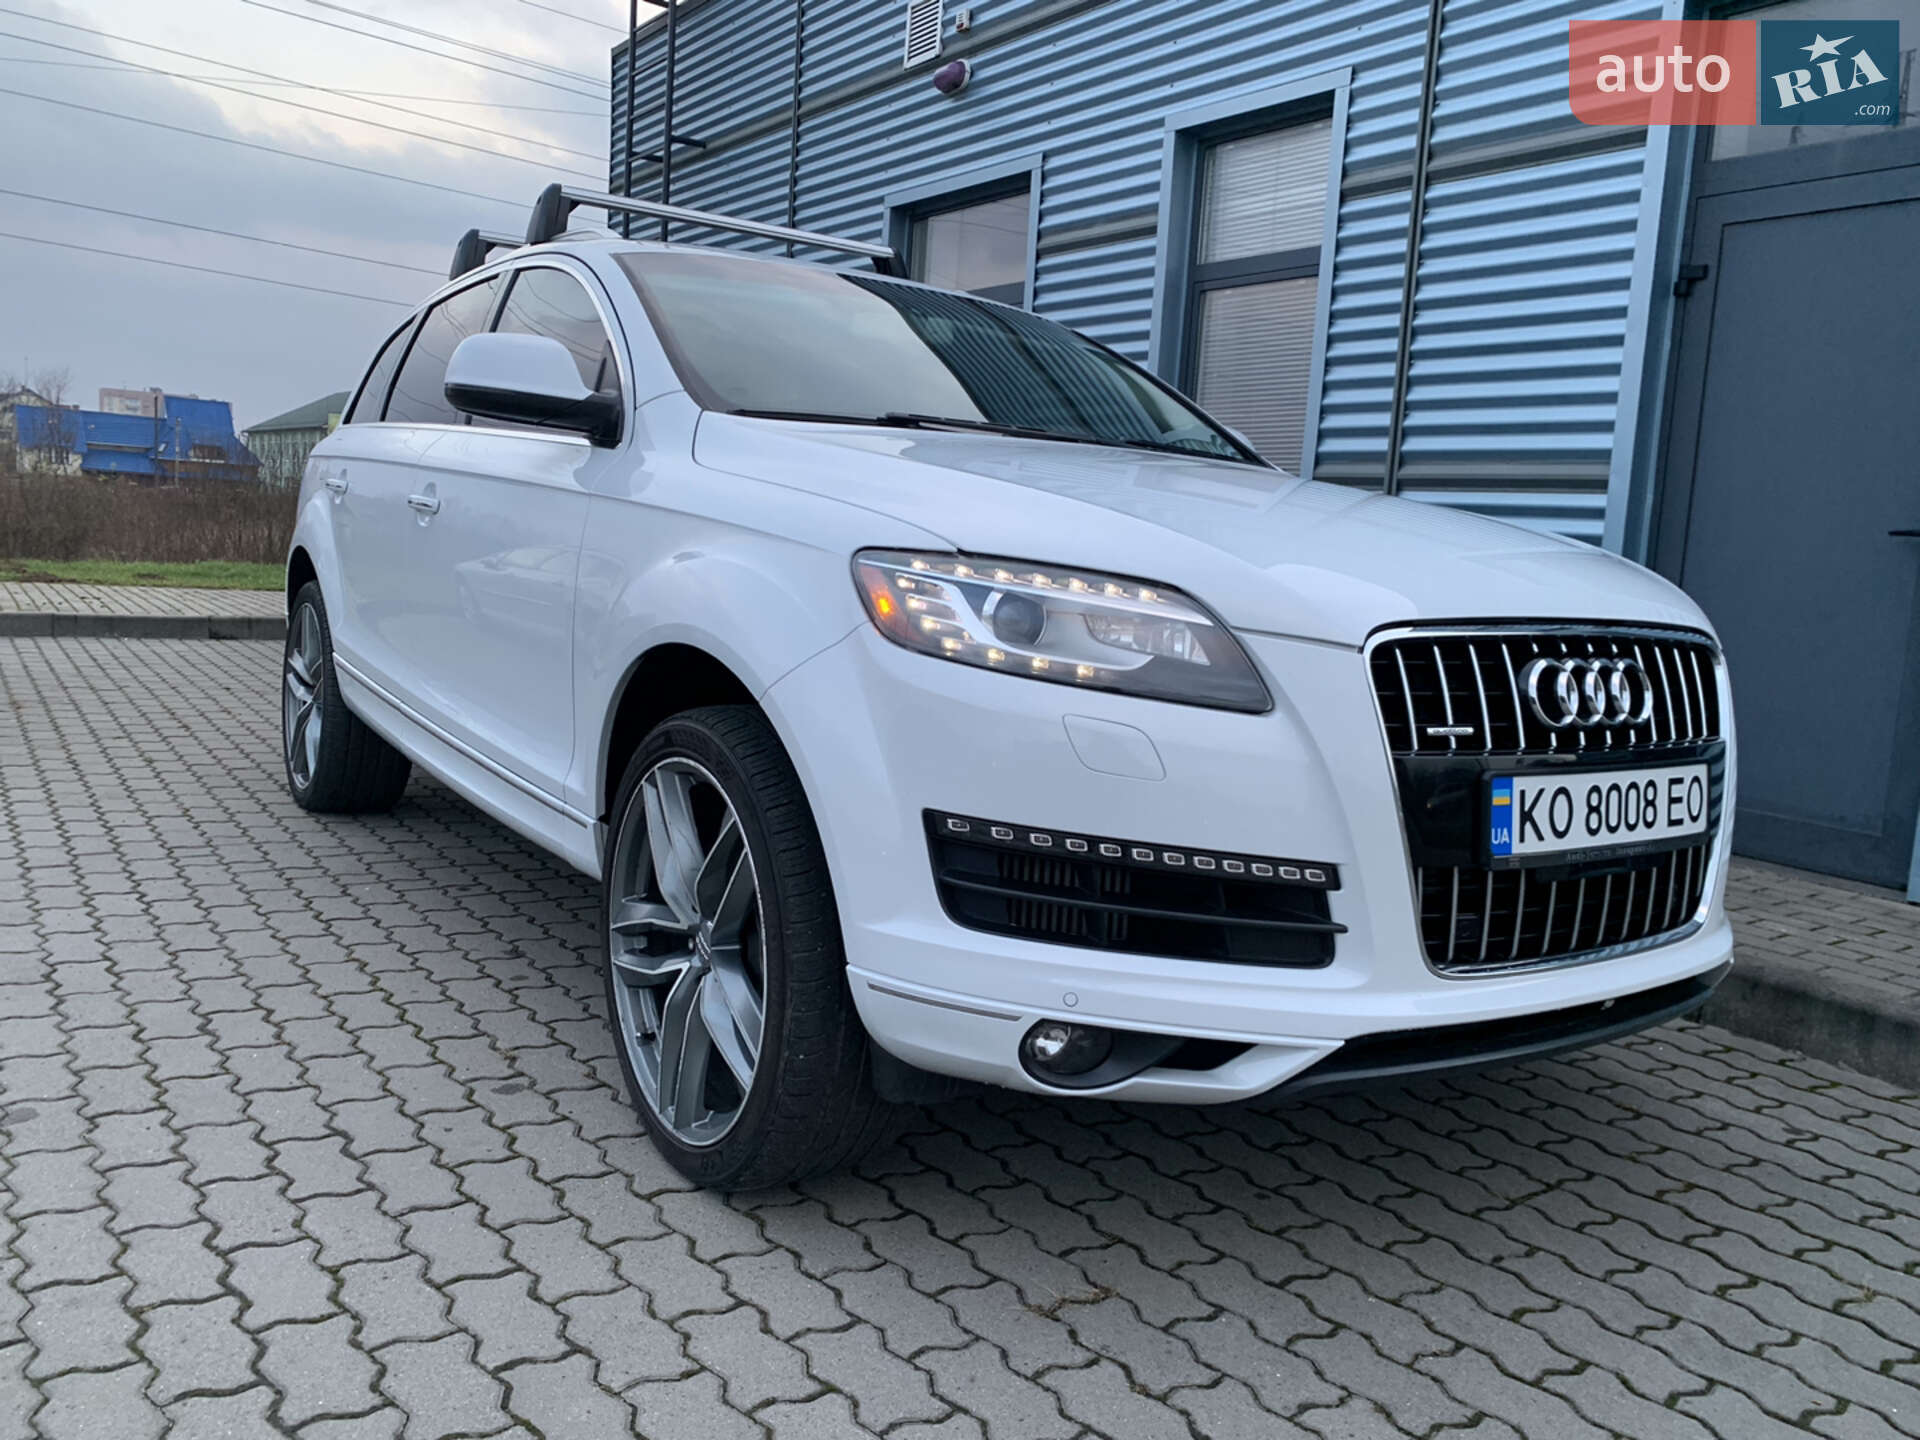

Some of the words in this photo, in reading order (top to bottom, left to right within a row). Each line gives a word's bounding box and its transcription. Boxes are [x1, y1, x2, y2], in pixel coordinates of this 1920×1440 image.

[1518, 786, 1574, 844] KO
[1585, 779, 1658, 837] 8008
[1666, 775, 1704, 828] EO
[1491, 827, 1510, 845] UA
